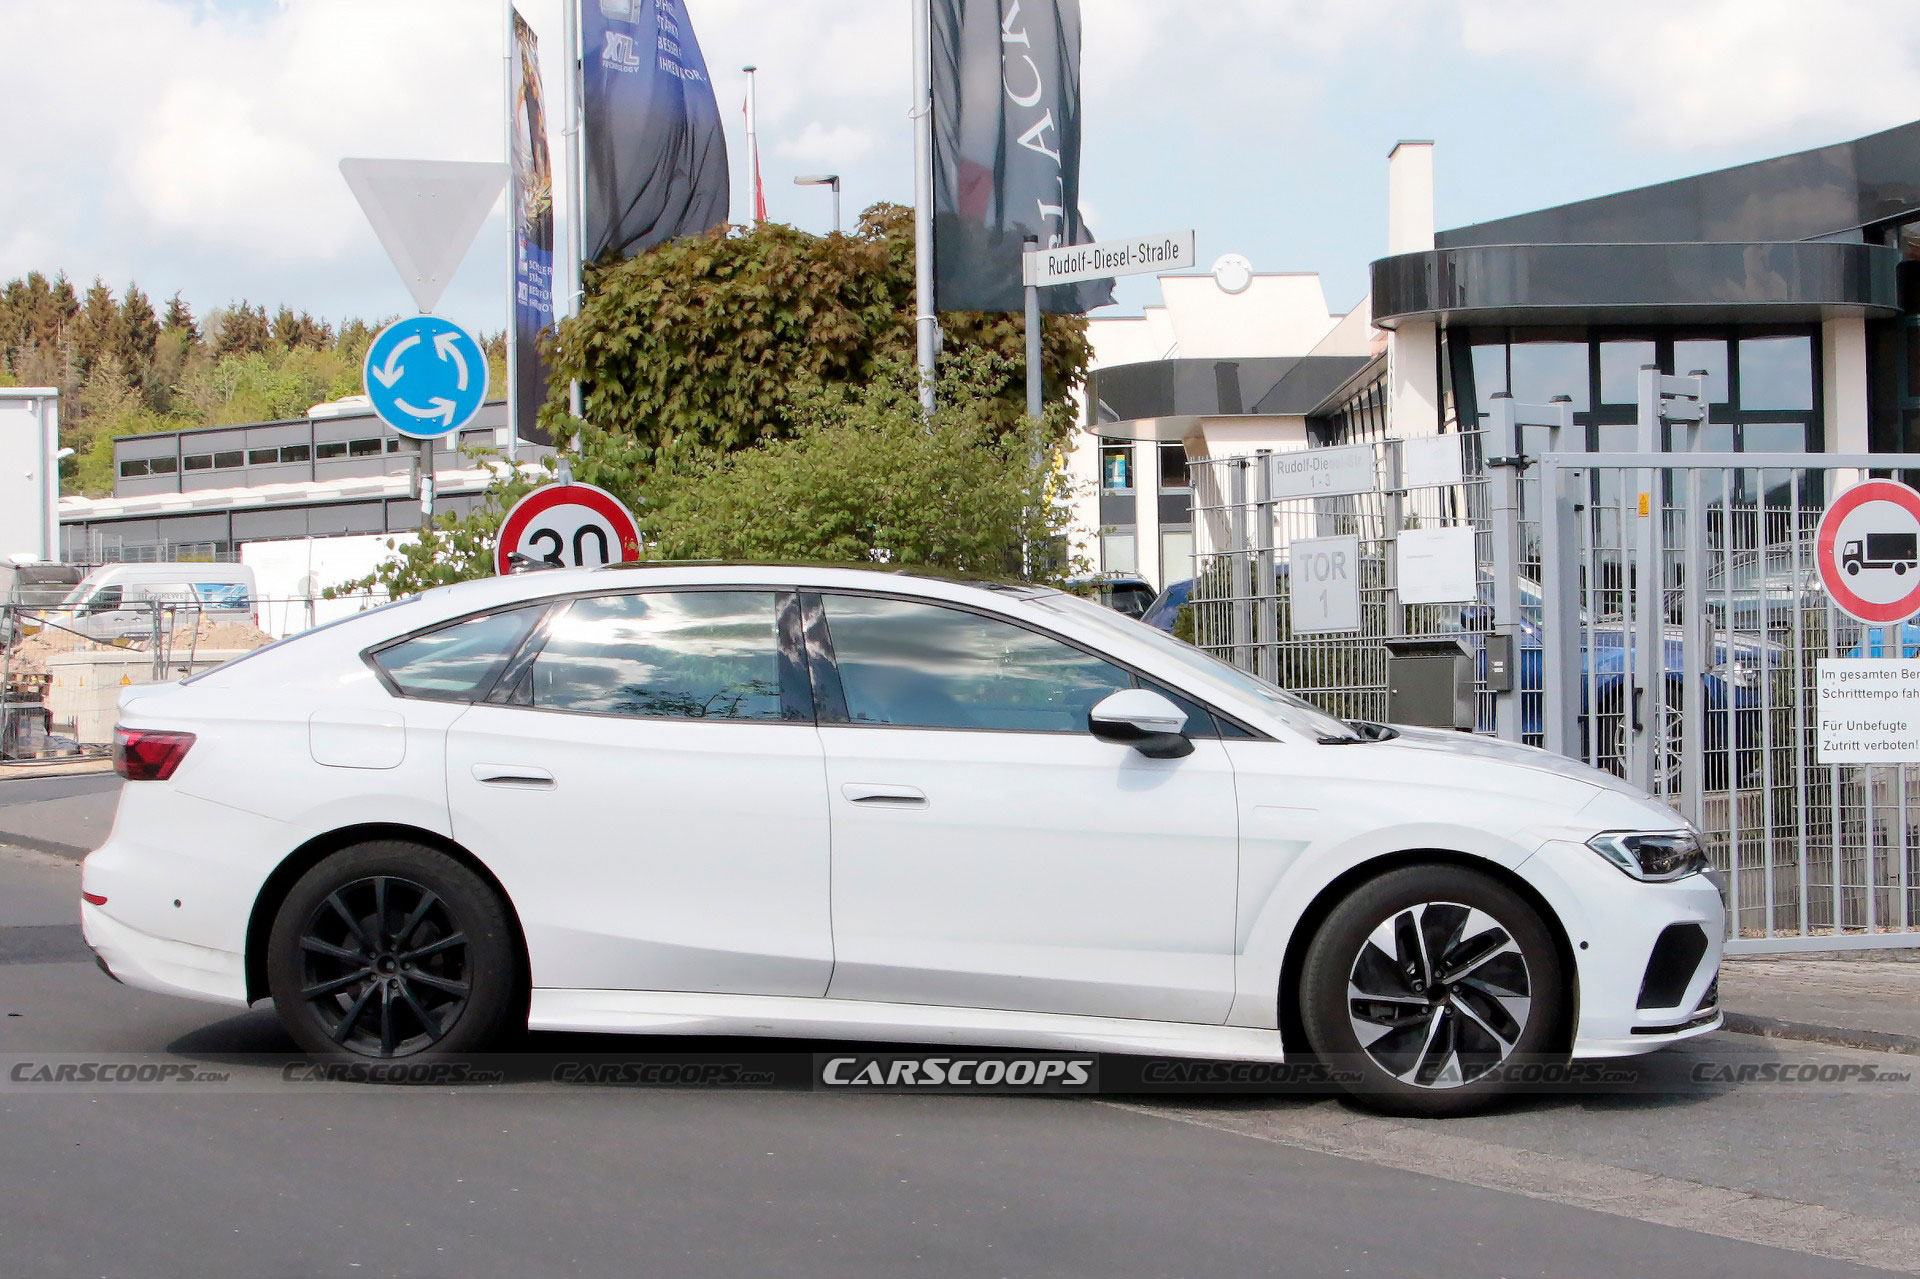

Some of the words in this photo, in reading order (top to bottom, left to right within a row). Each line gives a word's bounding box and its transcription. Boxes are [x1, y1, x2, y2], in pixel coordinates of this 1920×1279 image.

[1049, 239, 1179, 276] Rudolf-Diesel-Straße
[529, 524, 609, 568] 30
[1300, 551, 1347, 582] TOR
[1319, 588, 1328, 618] 1
[1821, 669, 1836, 679] Im
[1840, 669, 1897, 682] gesamten
[1822, 688, 1899, 700] Schritttempo
[1903, 687, 1920, 698] fah
[1822, 720, 1842, 731] Für
[1846, 720, 1907, 733] Unbefugte
[1823, 740, 1860, 751] Zutritt
[1864, 740, 1919, 750] verboten!
